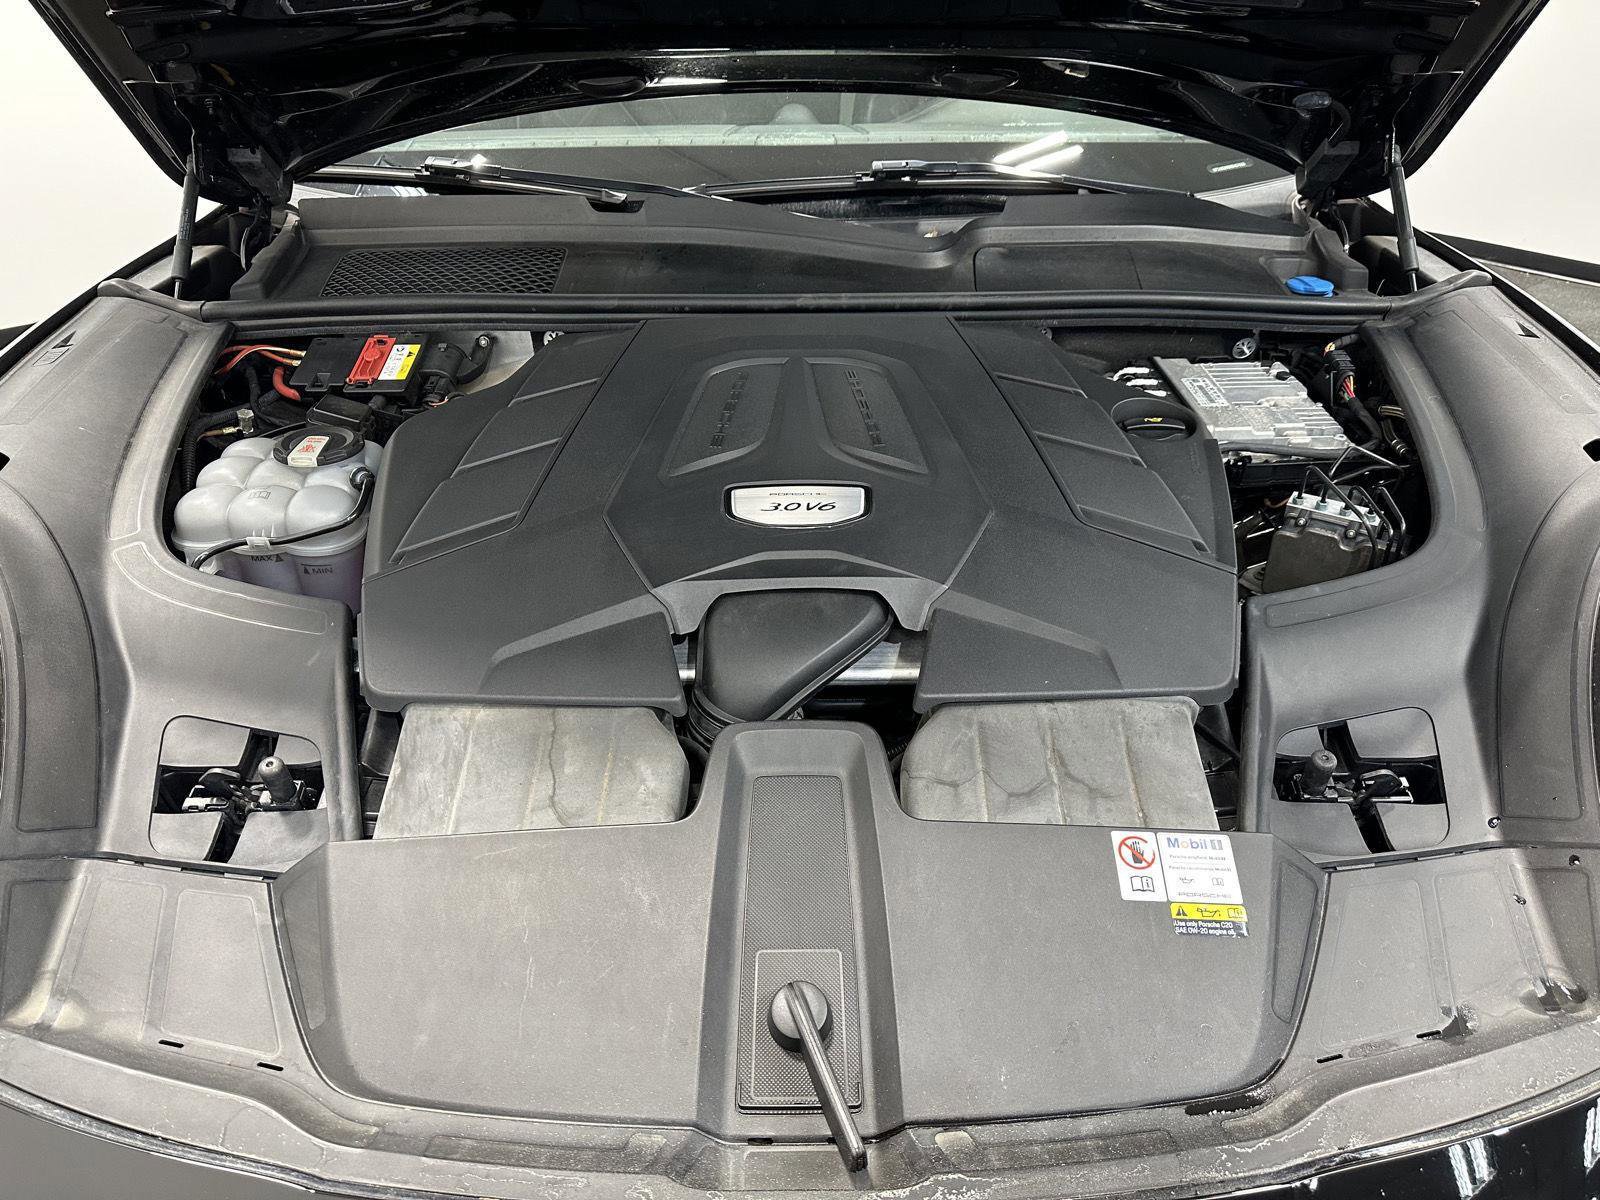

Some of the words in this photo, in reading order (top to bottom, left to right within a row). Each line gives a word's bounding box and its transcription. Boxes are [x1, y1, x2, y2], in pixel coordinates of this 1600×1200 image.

[760, 502, 802, 512] 3.0
[805, 502, 837, 512] V6
[312, 567, 334, 575] MIN
[1166, 837, 1208, 850] Mobil
